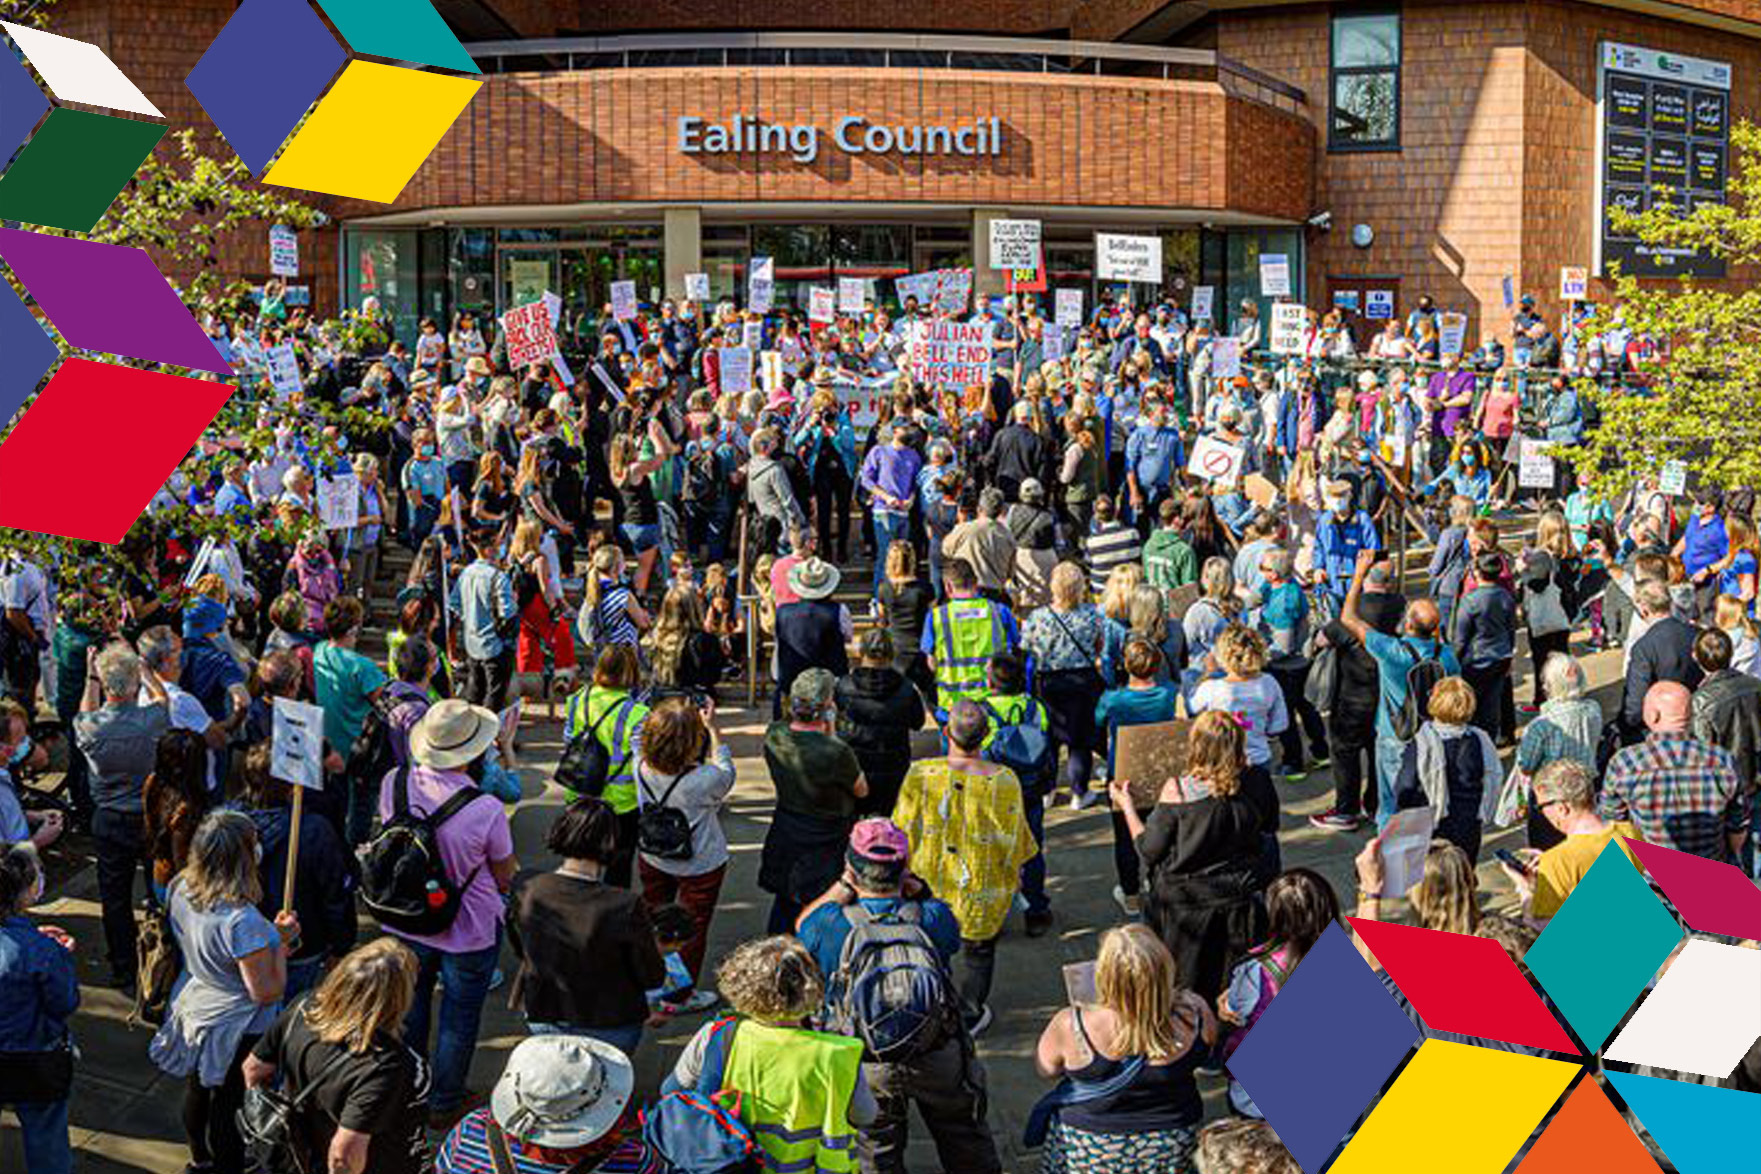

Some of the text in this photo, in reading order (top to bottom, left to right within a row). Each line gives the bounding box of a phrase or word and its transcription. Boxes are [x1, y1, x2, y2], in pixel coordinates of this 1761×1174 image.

[679, 114, 1000, 161] Ealing Council
[505, 302, 550, 328] GIVE US
[921, 322, 983, 342] JULIAN
[913, 362, 949, 383] THIS
